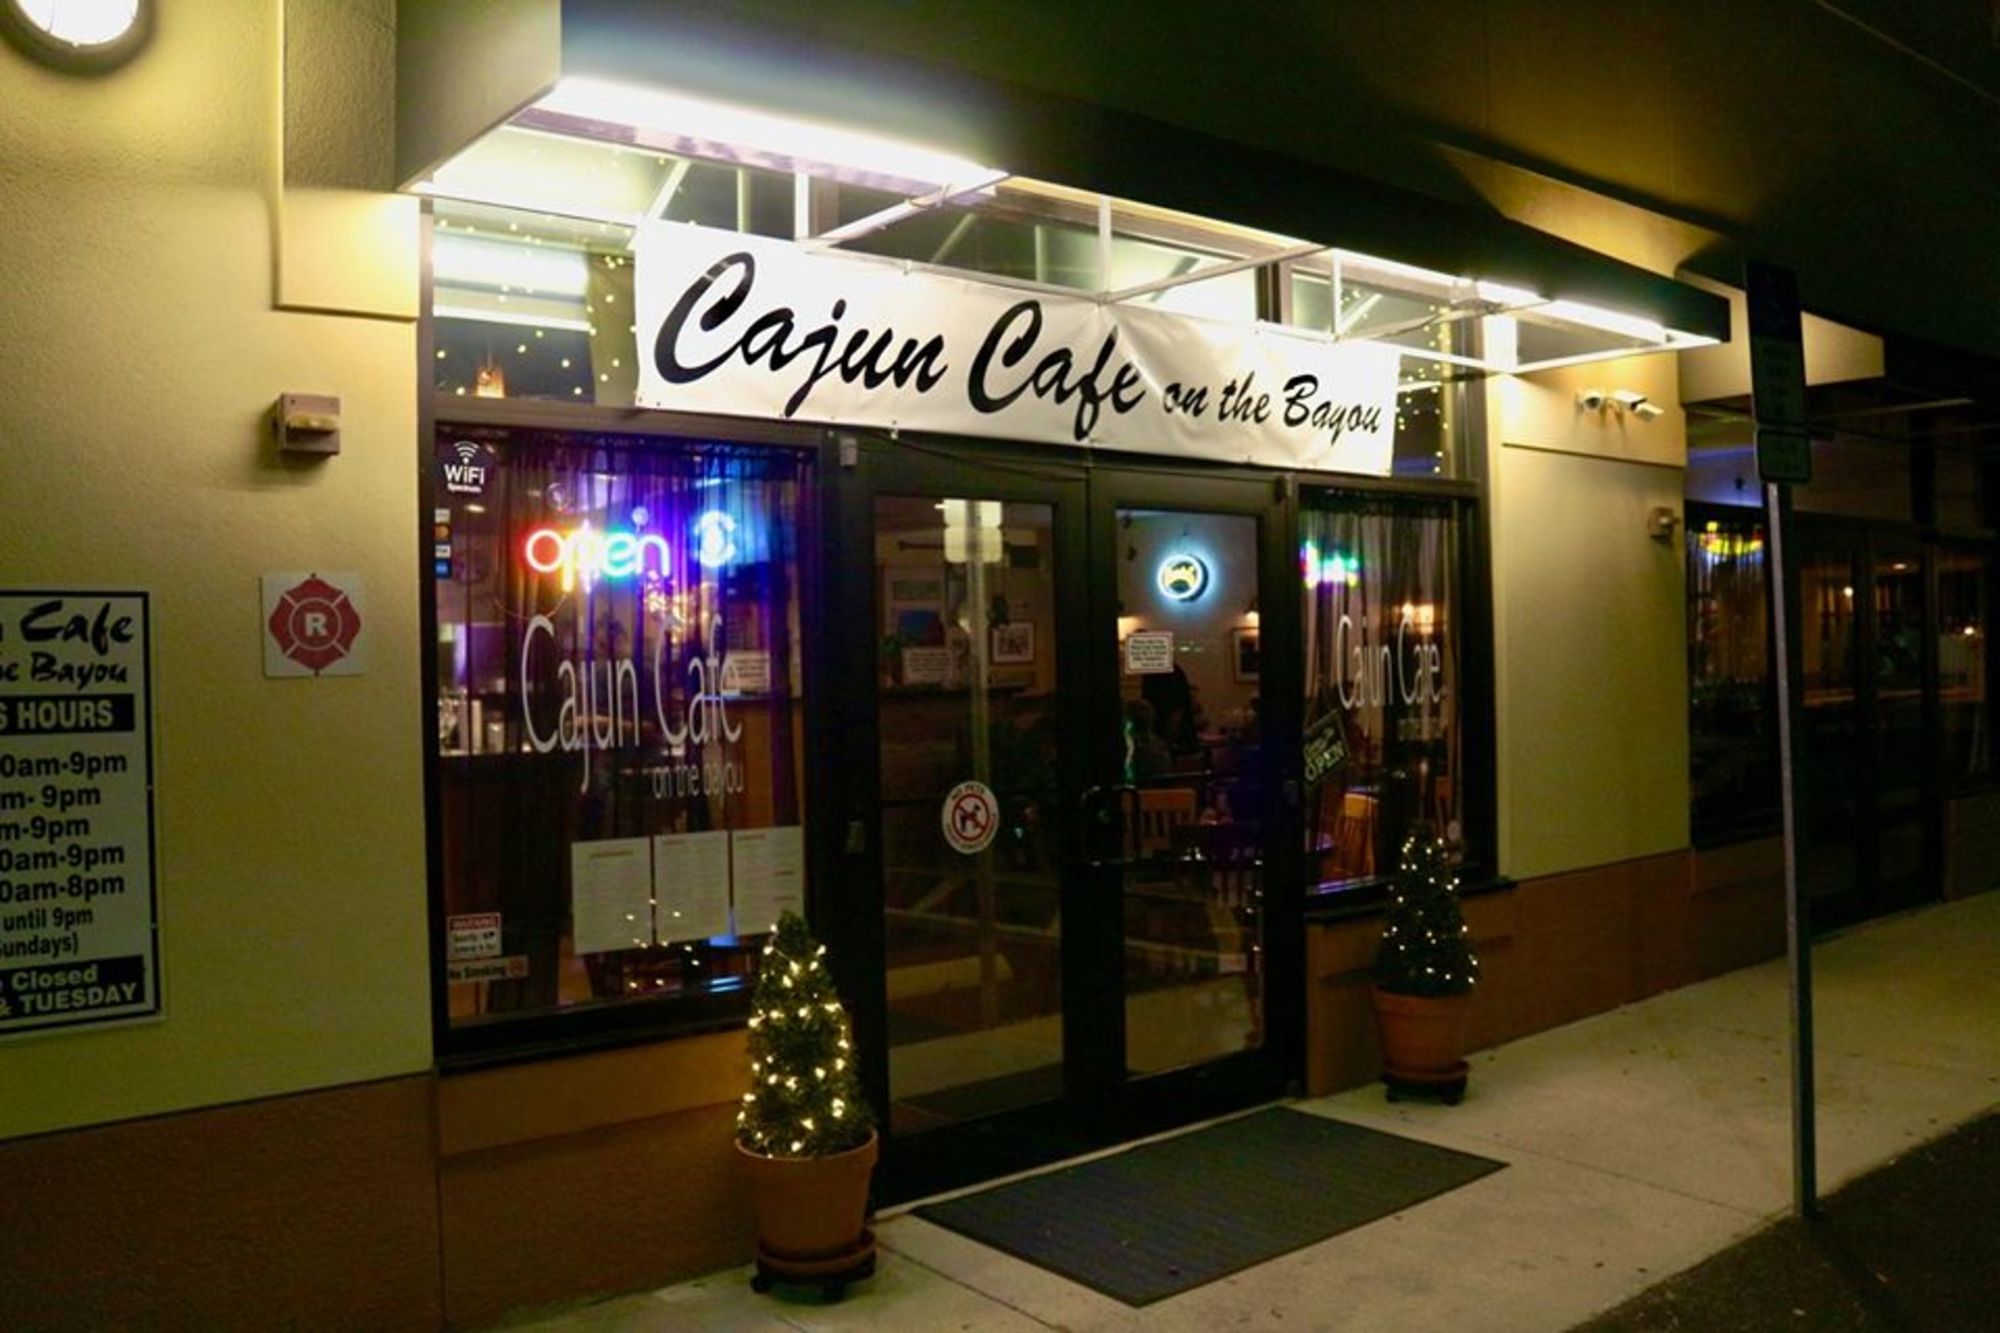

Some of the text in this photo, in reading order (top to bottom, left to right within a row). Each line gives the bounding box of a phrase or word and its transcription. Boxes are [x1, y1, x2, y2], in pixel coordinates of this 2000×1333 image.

[653, 251, 1382, 446] Cajun Cafe on the Bayou
[442, 461, 485, 486] WiFi
[525, 528, 671, 592] open
[19, 600, 134, 656] Cafe
[304, 612, 328, 637] R
[31, 651, 128, 690] Bayou
[16, 699, 115, 730] HOURS
[521, 613, 641, 795] Cajun
[4, 907, 94, 931] until 9pm
[11, 964, 98, 991] Closed
[19, 982, 137, 1014] TUESDAY
